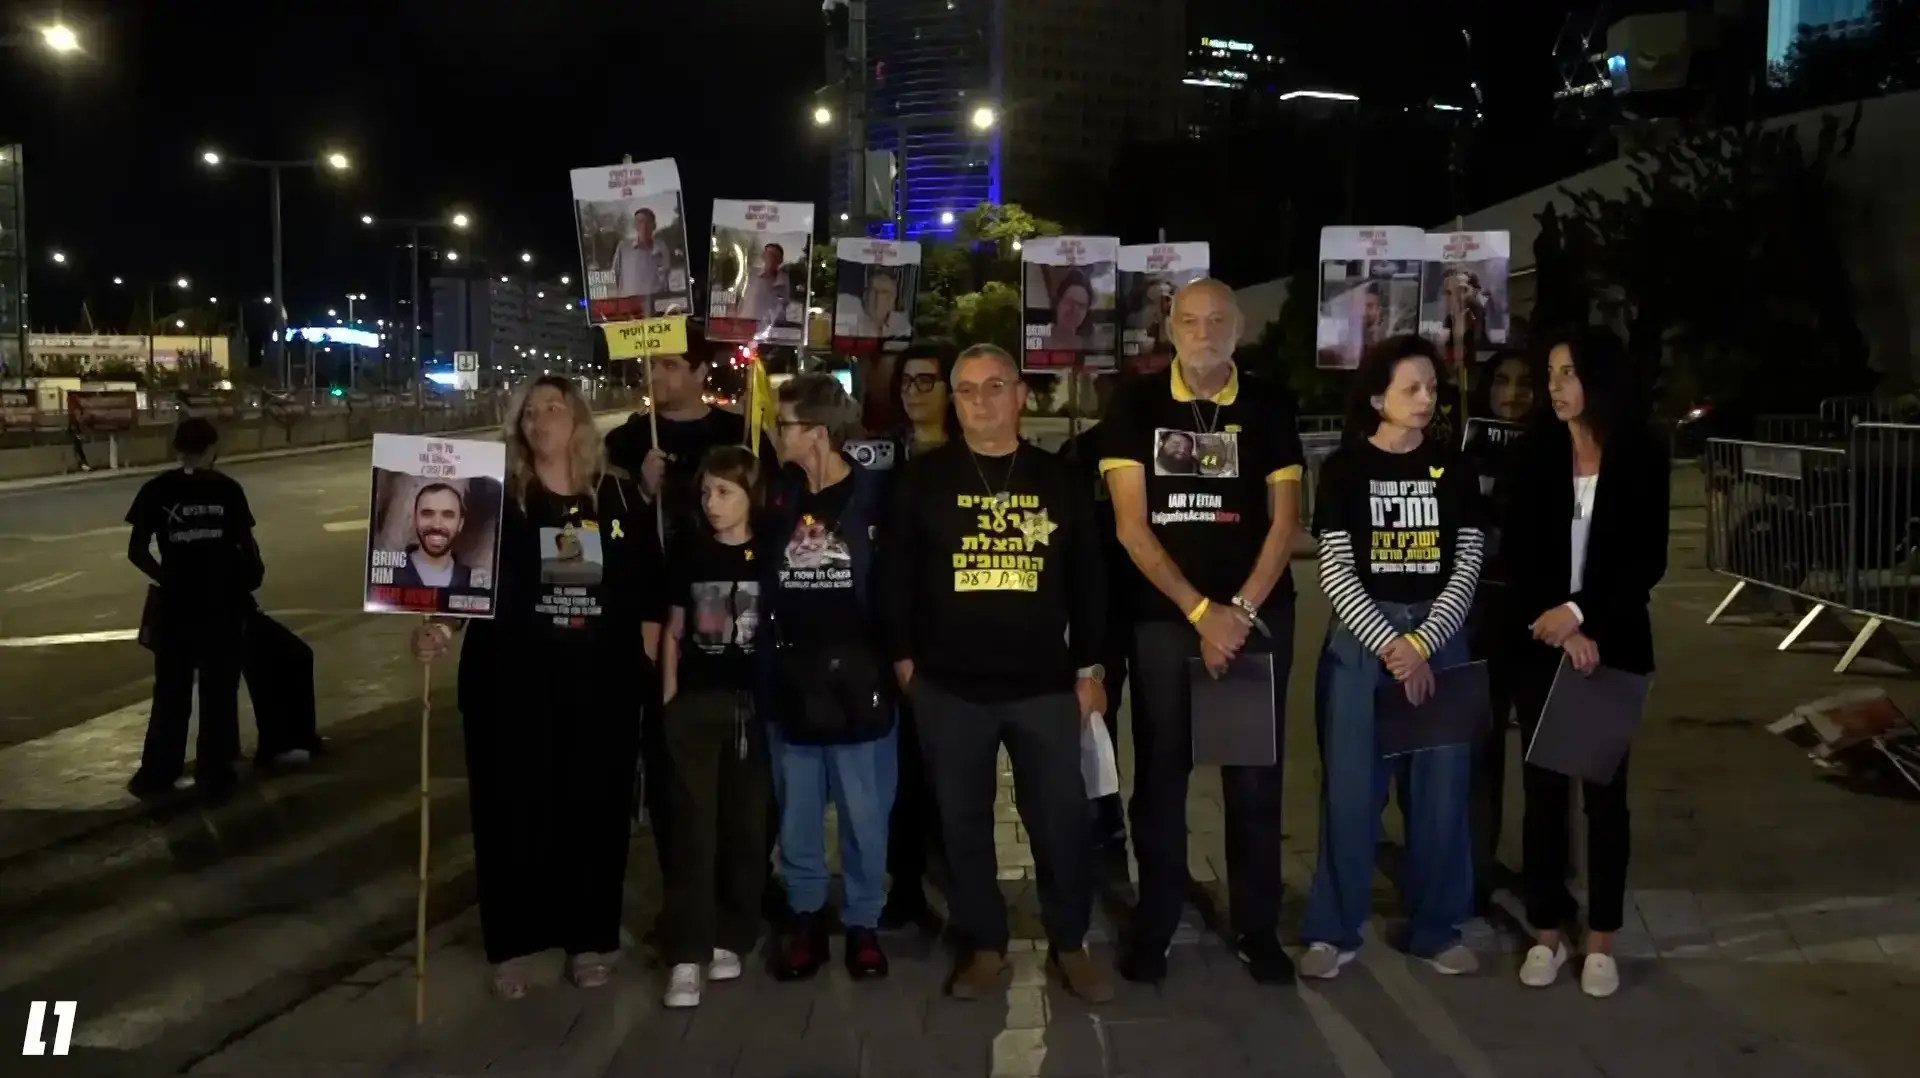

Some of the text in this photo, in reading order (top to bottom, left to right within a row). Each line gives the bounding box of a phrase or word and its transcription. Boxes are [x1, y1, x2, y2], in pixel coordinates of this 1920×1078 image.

[648, 323, 672, 334] אבא
[634, 339, 661, 350] בעה
[1400, 481, 1437, 496] יושבים
[1168, 493, 1222, 508] IAIR Y EITAN
[1370, 496, 1440, 528] מחכים
[961, 533, 1023, 551] הצלת
[1398, 530, 1440, 548] יושבים
[372, 550, 407, 568] BRING
[952, 553, 1045, 571] החטופים
[371, 567, 394, 584] HIM
[794, 570, 814, 580] now
[827, 567, 852, 580] Gaza
[960, 571, 992, 586] רעב
